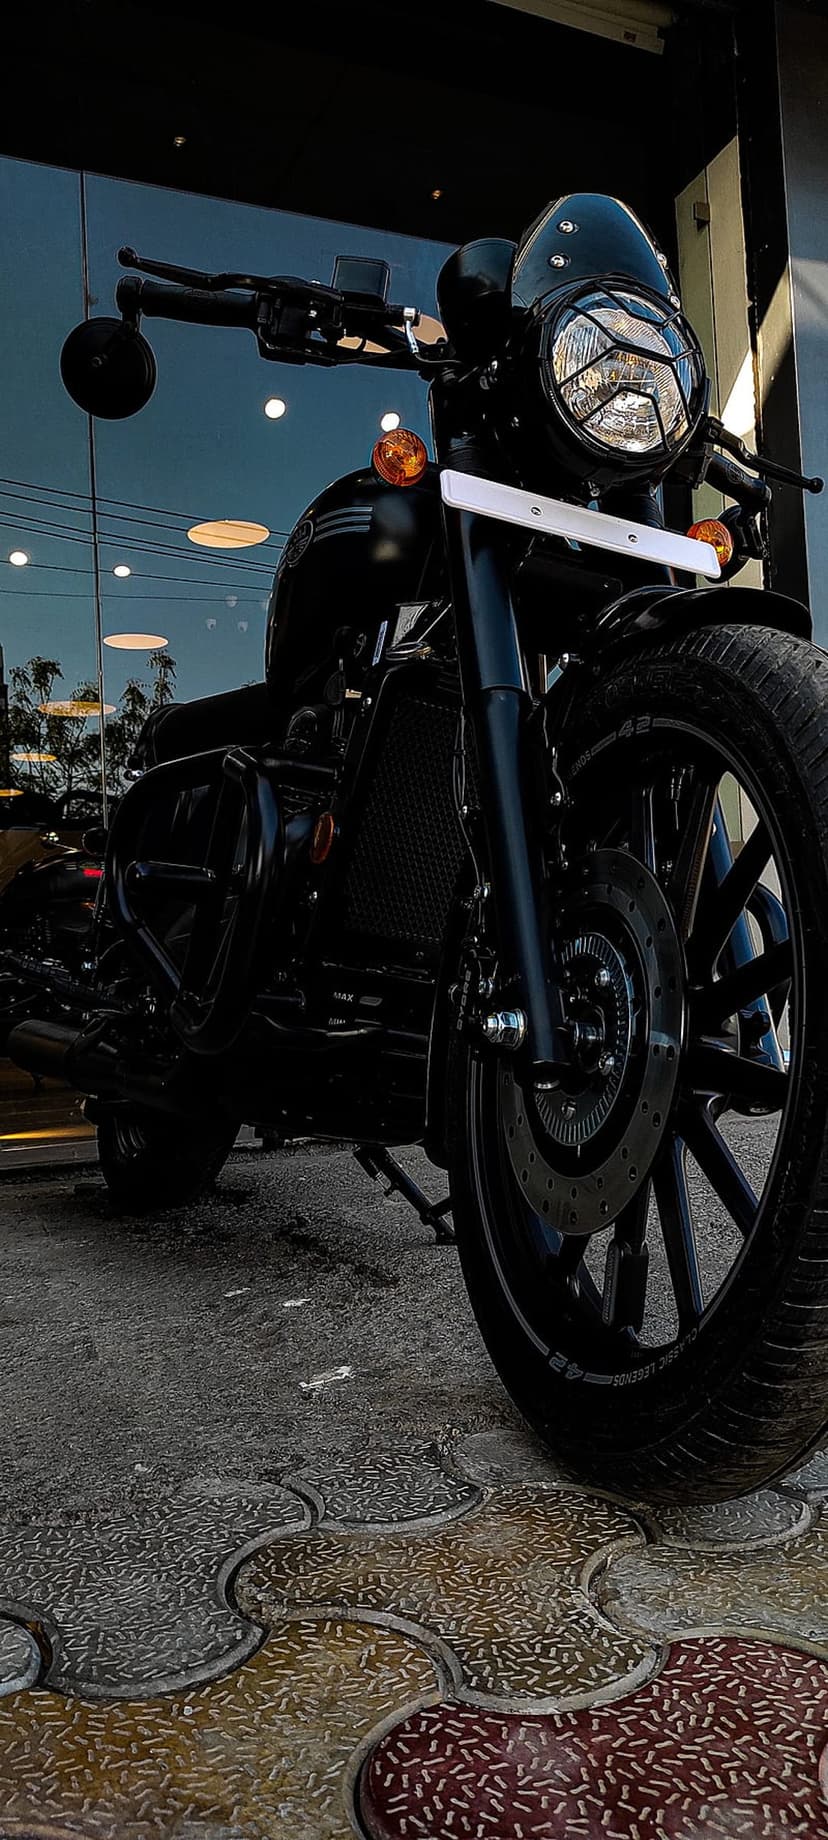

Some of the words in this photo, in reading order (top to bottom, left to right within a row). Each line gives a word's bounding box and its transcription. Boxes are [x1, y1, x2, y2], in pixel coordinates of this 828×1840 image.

[618, 716, 652, 737] 42
[333, 991, 355, 1002] MAX
[658, 1328, 698, 1370] CLASSIC
[549, 1351, 585, 1380] 42
[613, 1362, 656, 1387] LEGENDS
